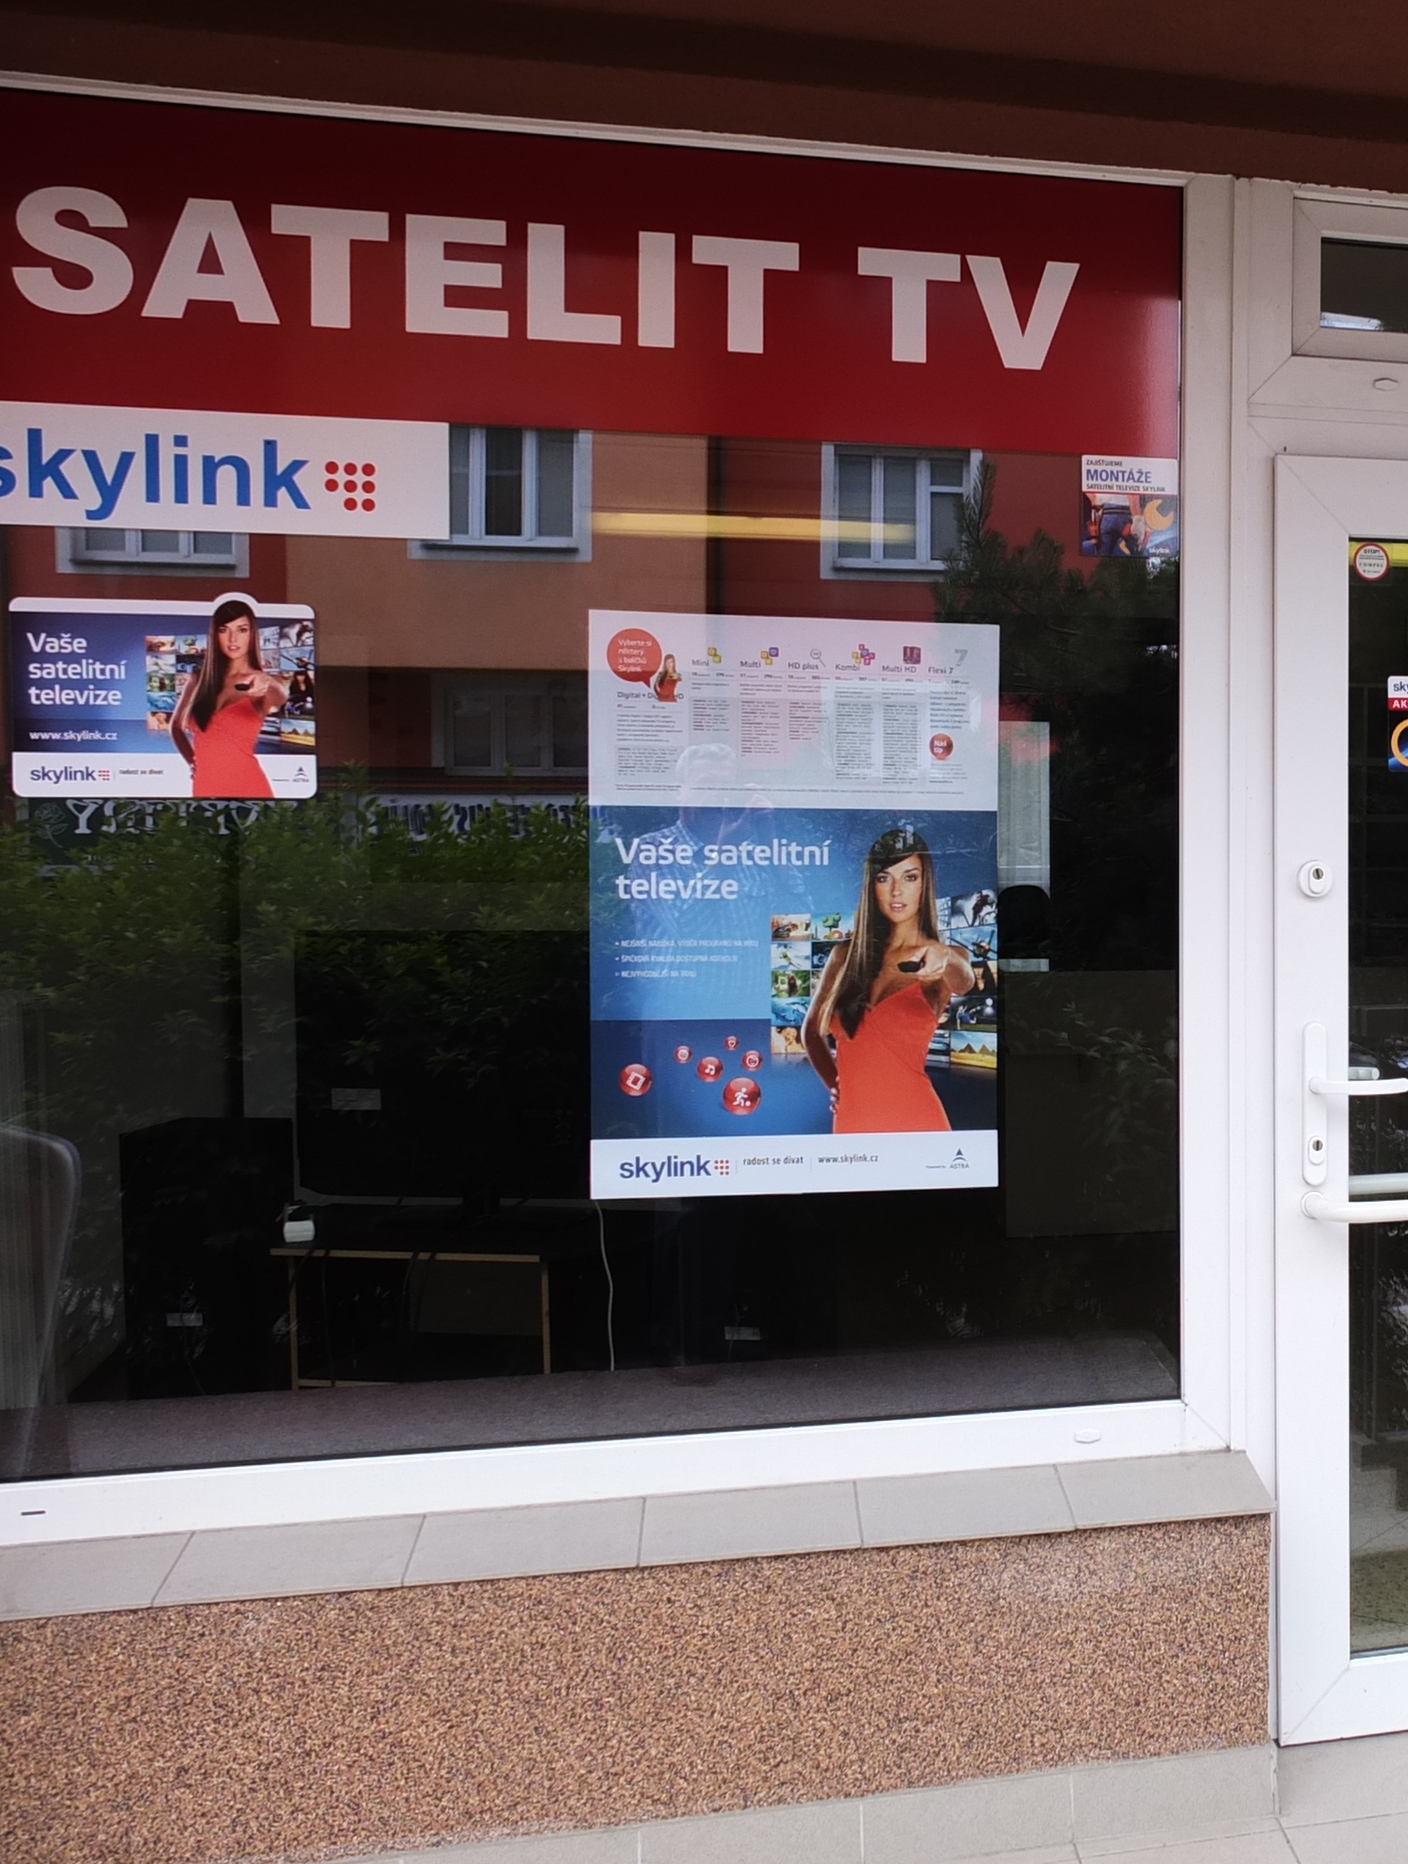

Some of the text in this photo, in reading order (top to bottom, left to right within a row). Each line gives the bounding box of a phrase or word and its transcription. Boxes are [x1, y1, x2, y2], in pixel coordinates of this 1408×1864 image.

[12, 186, 1080, 371] SATELIT TV
[1086, 468, 1152, 484] MONTÁŽE
[27, 632, 88, 654] Vaše
[28, 659, 127, 680] satelitní
[740, 660, 761, 668] Multi
[802, 662, 819, 670] plus
[882, 665, 902, 673] Multi
[28, 685, 122, 706] televize
[617, 691, 641, 699] Digital
[29, 729, 118, 743] www.skylink.cz
[30, 766, 96, 784] skylink
[615, 838, 832, 866] Vaše satelitní
[615, 872, 739, 900] televize
[619, 1154, 711, 1182] skylink
[743, 1157, 769, 1165] radost
[772, 1157, 780, 1165] se
[818, 1154, 878, 1165] www.skylink.cz
